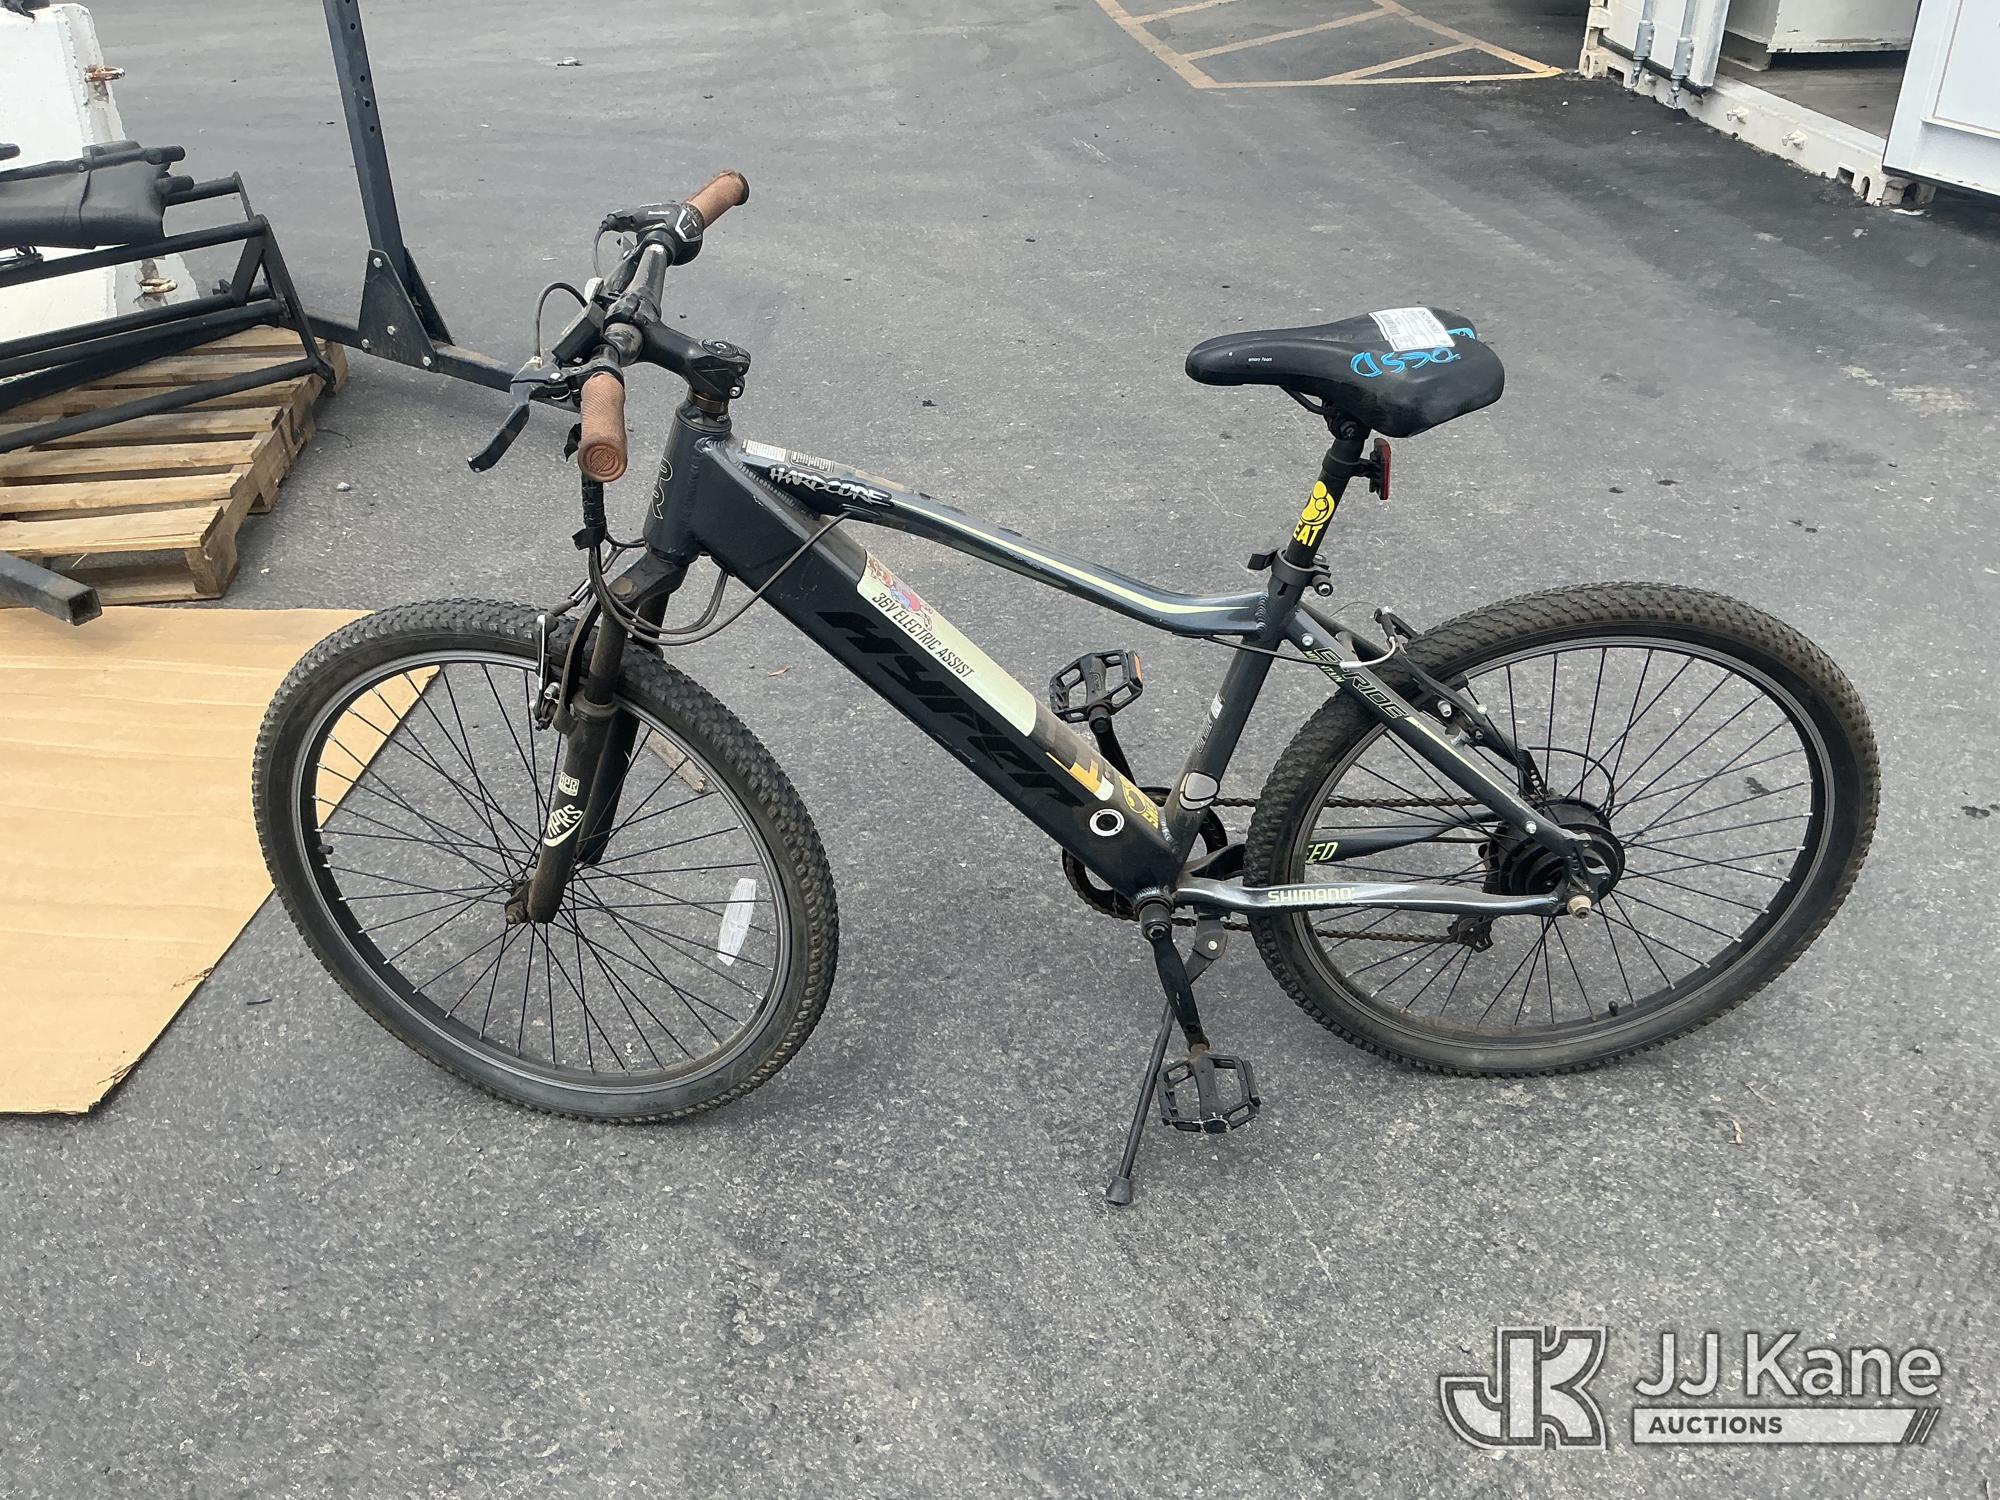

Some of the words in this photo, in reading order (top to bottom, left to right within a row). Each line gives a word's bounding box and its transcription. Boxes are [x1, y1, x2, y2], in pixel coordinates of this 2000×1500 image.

[769, 466, 894, 506] HARDCORE
[872, 592, 900, 619] 36V
[893, 609, 941, 651] ELECTRIC
[935, 647, 975, 679] ASSIST
[1302, 650, 1345, 683] MONTAIN
[816, 611, 1085, 808] HYPER
[1267, 887, 1352, 903] SHIMANO
